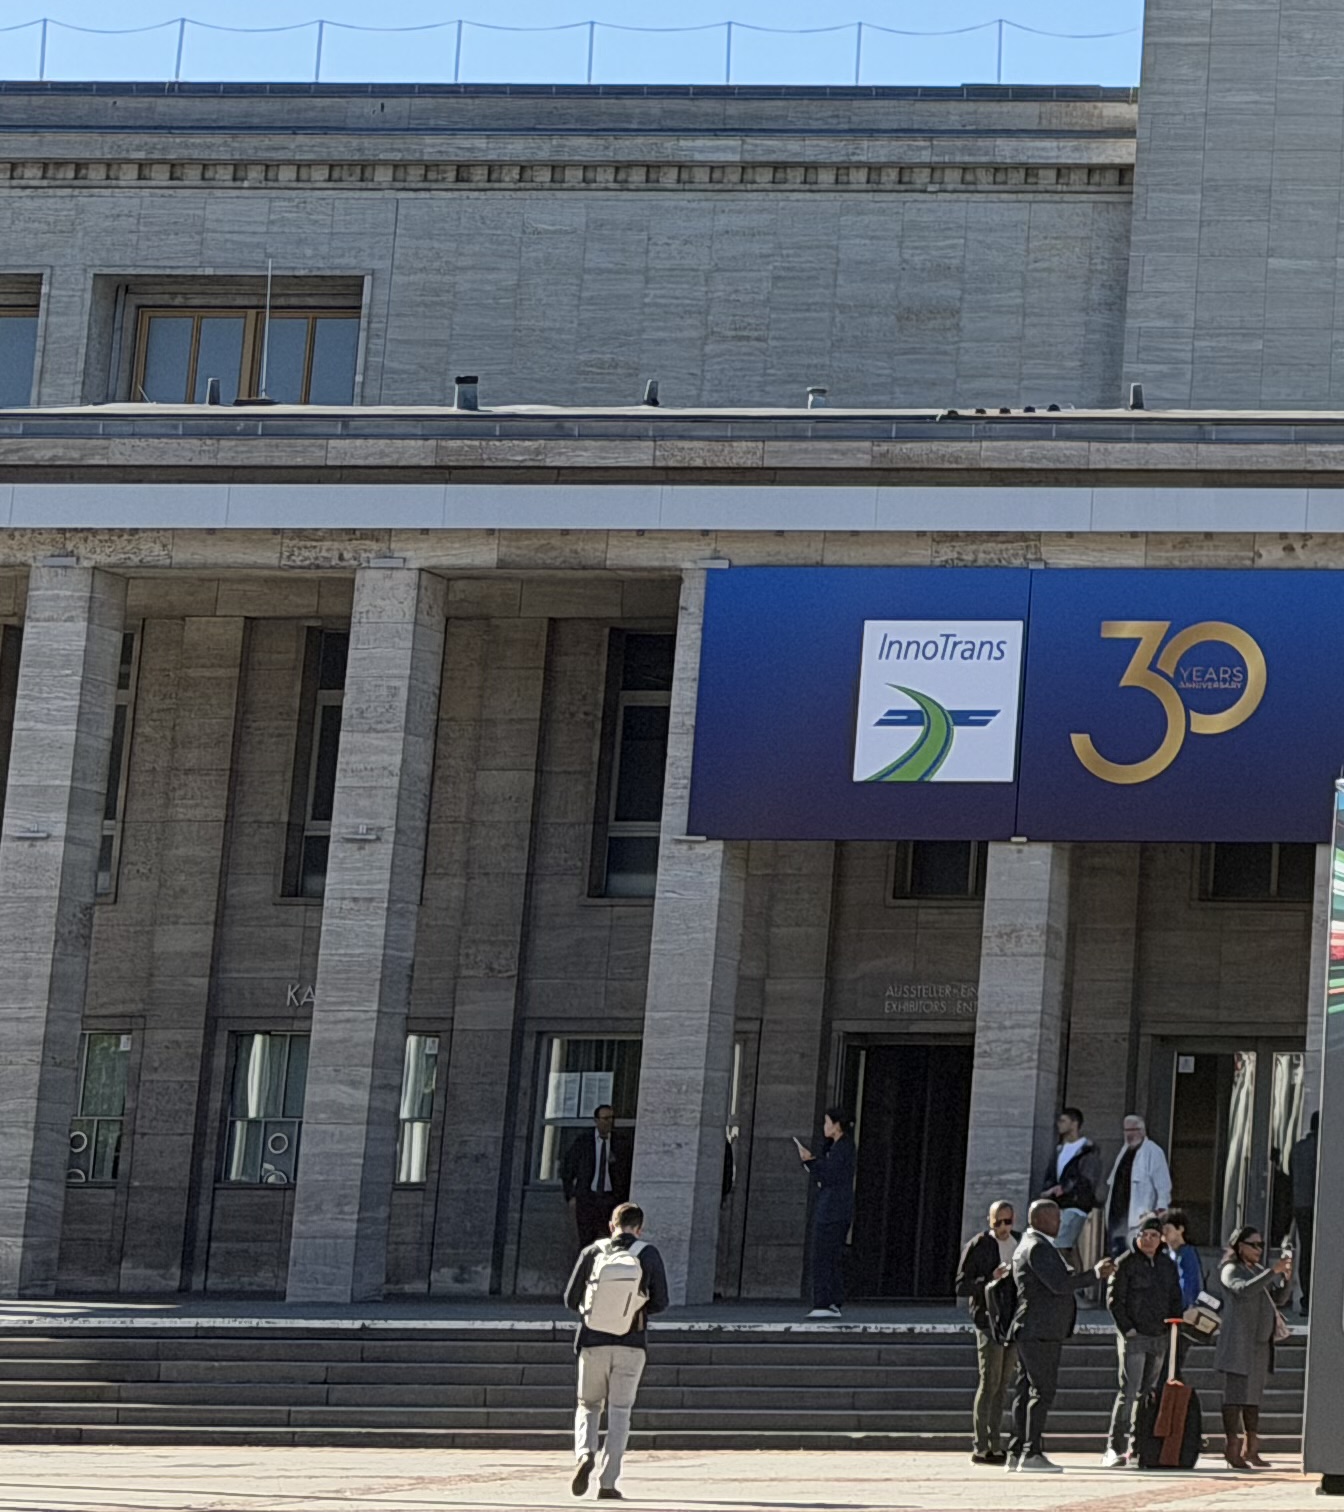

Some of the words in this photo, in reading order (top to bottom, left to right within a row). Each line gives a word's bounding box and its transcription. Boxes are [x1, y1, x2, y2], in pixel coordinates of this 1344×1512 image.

[878, 633, 1007, 661] InnoTrans
[1180, 666, 1244, 681] YEARS
[1070, 620, 1268, 785] 30
